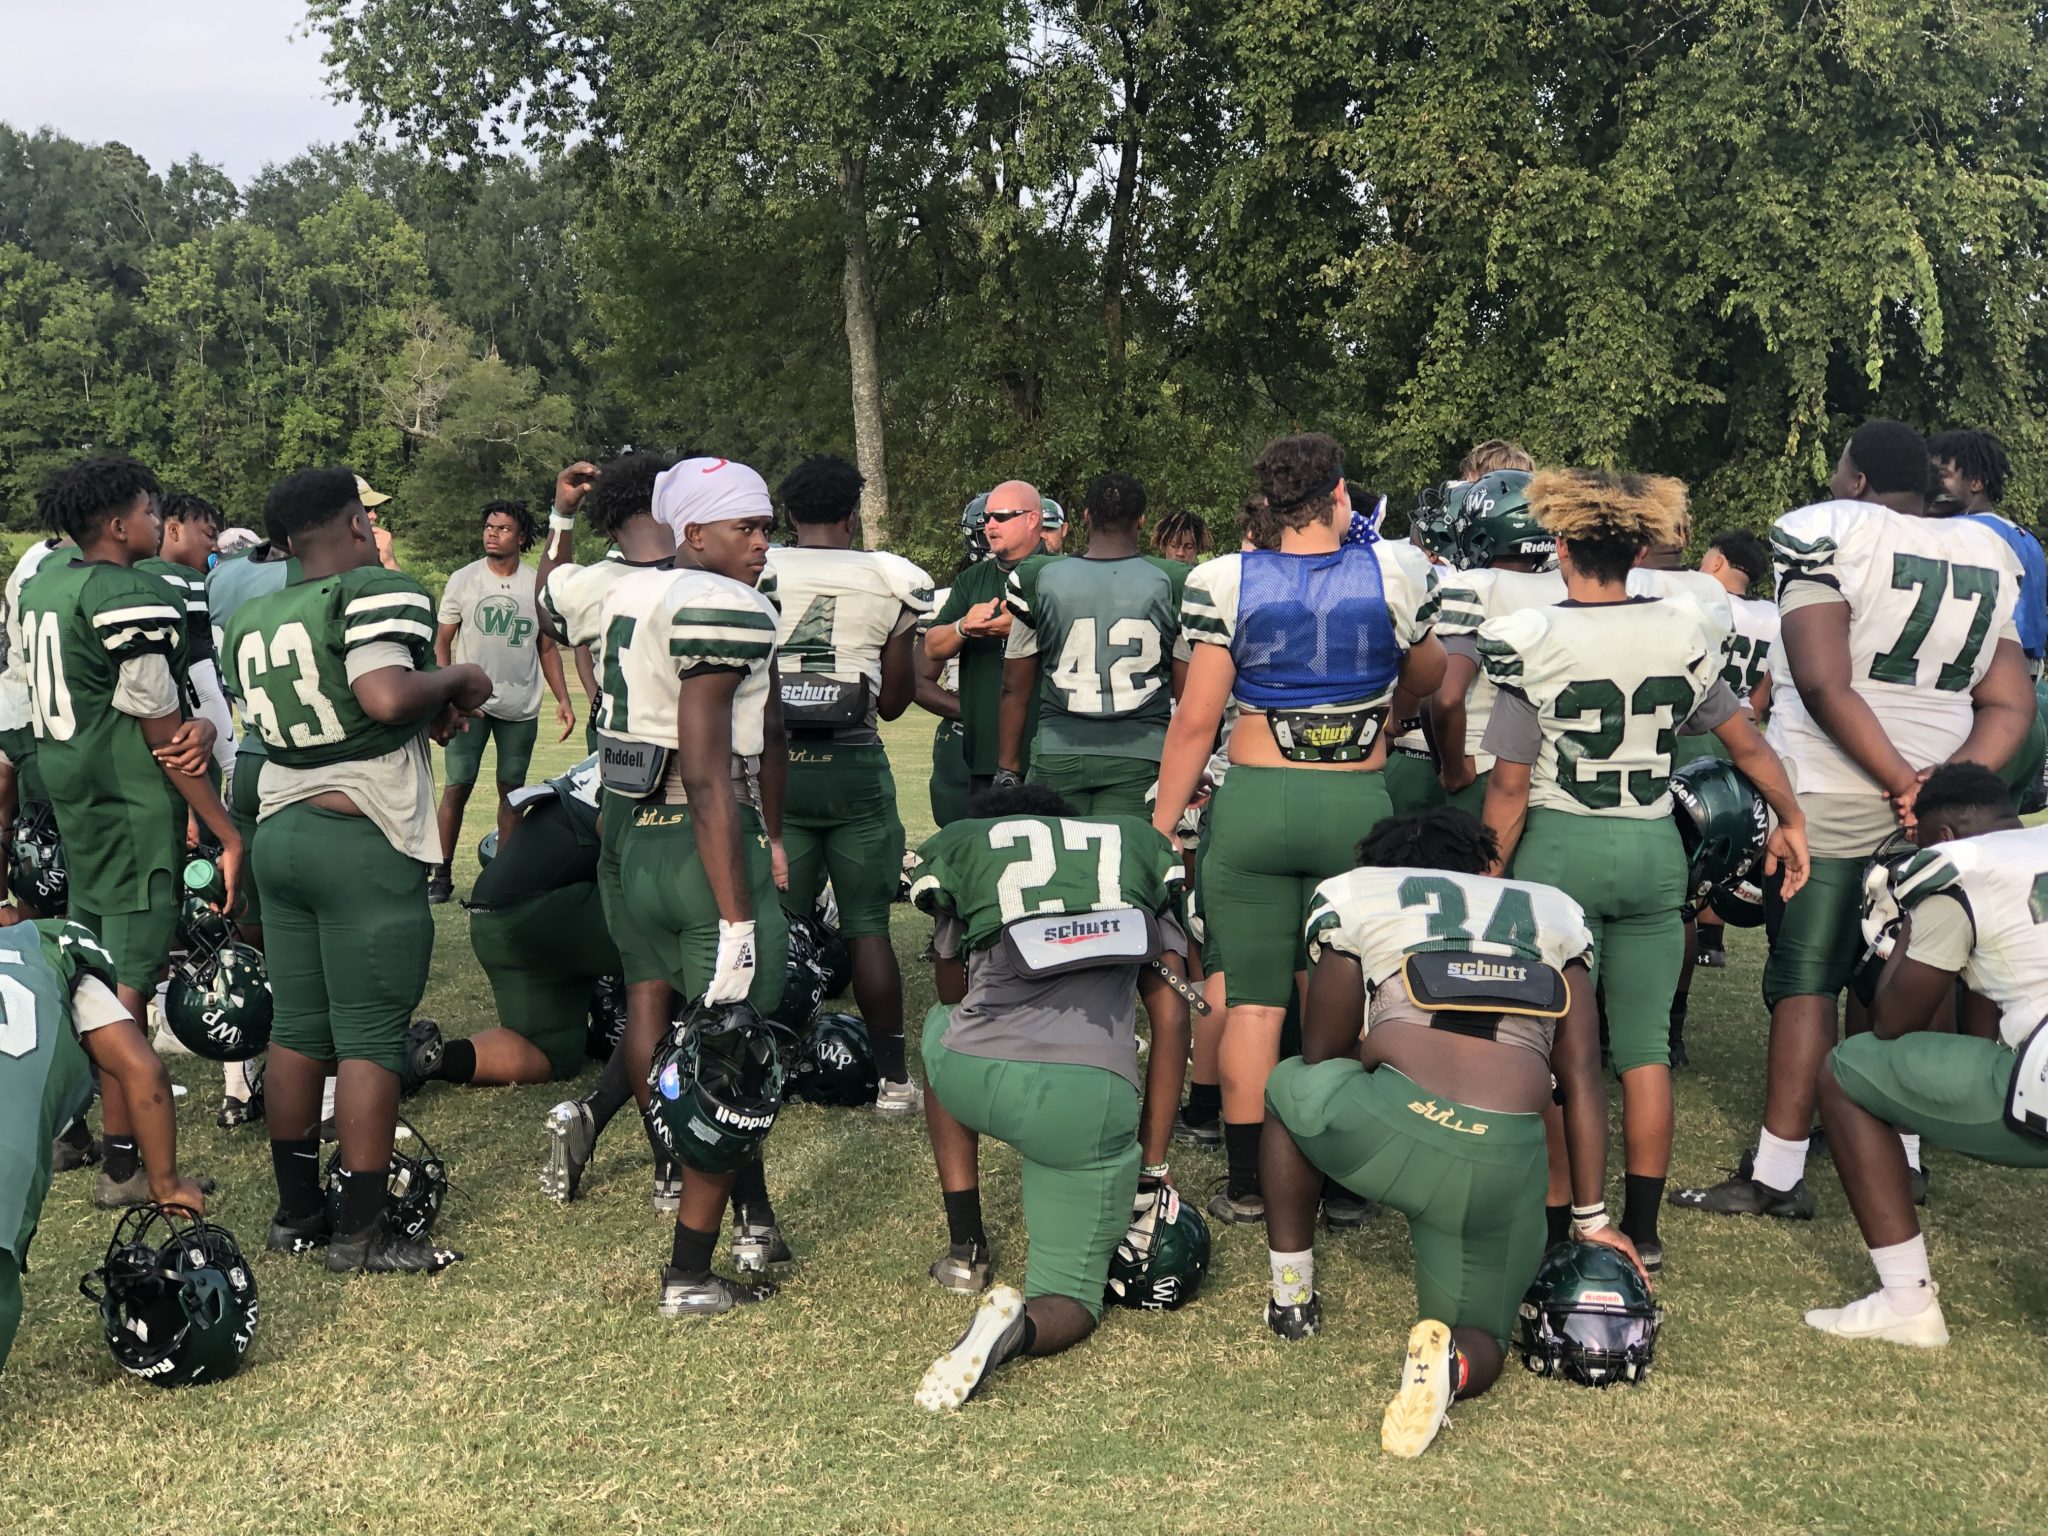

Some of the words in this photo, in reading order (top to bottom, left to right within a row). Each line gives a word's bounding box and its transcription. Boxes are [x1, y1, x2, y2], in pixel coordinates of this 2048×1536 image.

[1468, 488, 1495, 518] WP
[1521, 541, 1558, 554] Ridde
[482, 606, 534, 647] WP
[777, 595, 836, 673] 4
[1869, 552, 1999, 692] 77
[1051, 618, 1162, 712] 42
[238, 622, 346, 748] 63
[781, 681, 841, 701] schutt
[604, 748, 644, 768] Riddell
[789, 748, 833, 762] ULLS
[1555, 676, 1695, 809] 23
[636, 807, 683, 827] BULLS
[988, 818, 1133, 925] 27
[1044, 919, 1120, 942] schutt
[1397, 876, 1542, 962] 34
[733, 942, 748, 970] adidas
[1447, 960, 1527, 981] schutt
[201, 1009, 239, 1044] WP
[821, 1043, 852, 1070] WP
[715, 1106, 774, 1130] Riddell
[1407, 1100, 1489, 1135] BULLS
[234, 1305, 257, 1353] WP
